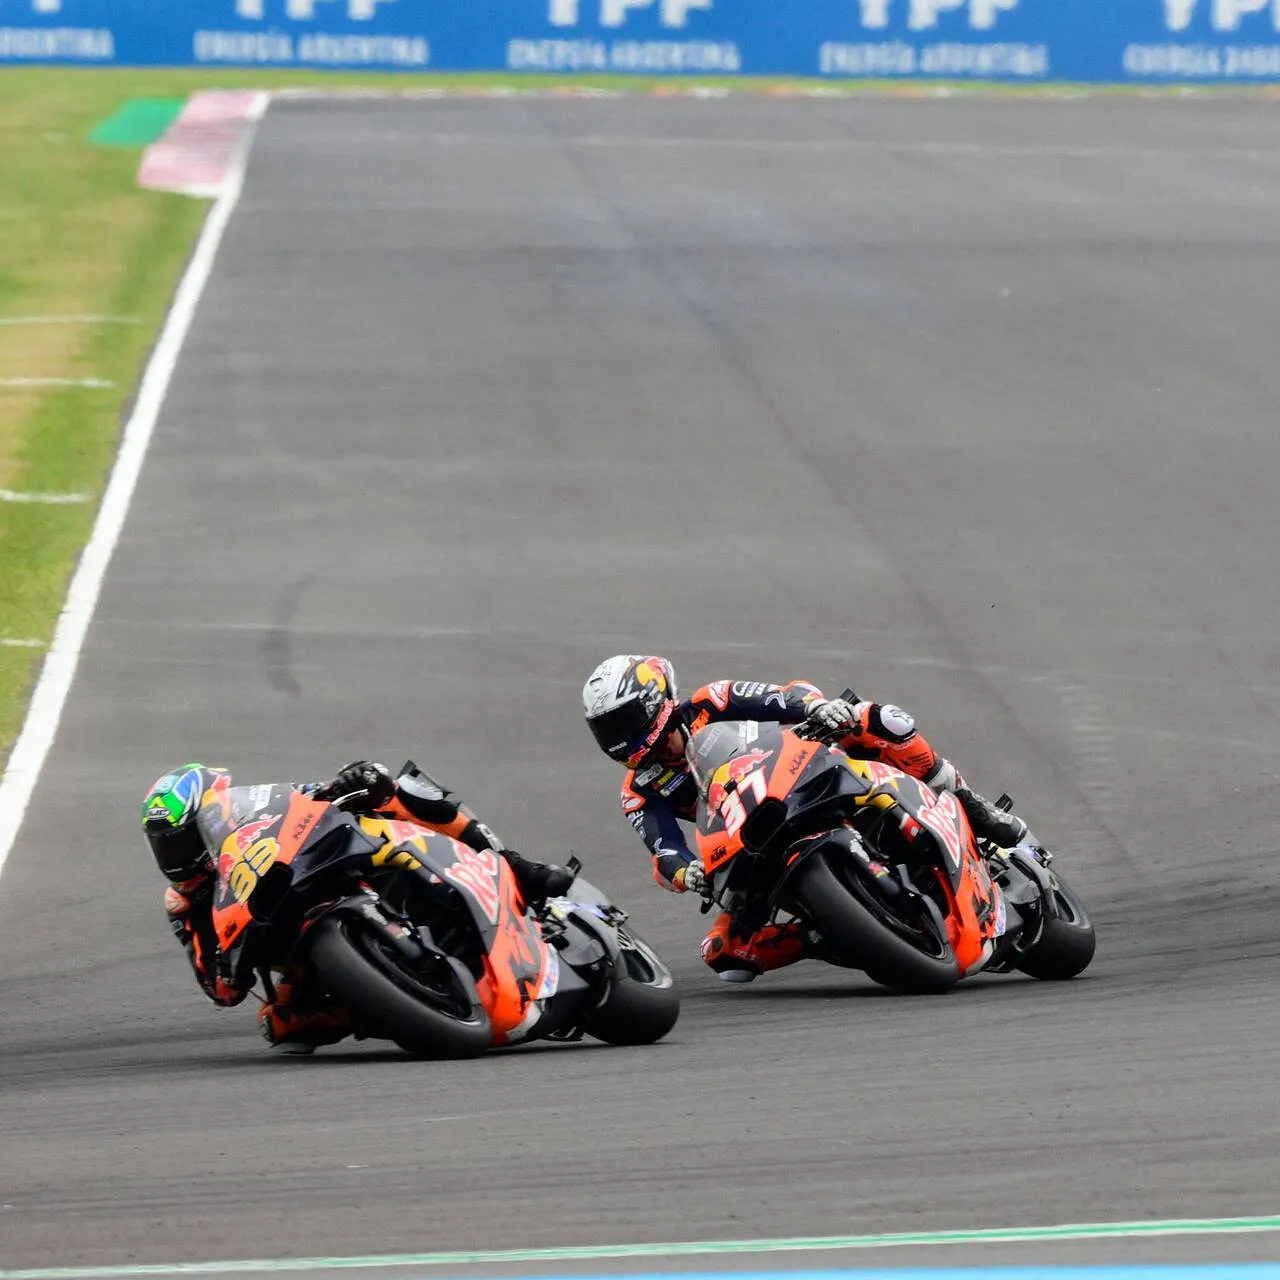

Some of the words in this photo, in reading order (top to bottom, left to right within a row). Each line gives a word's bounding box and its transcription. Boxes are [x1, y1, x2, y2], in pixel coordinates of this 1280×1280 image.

[720, 764, 768, 841] 37
[230, 836, 281, 907] 33
[710, 844, 728, 864] KTM
